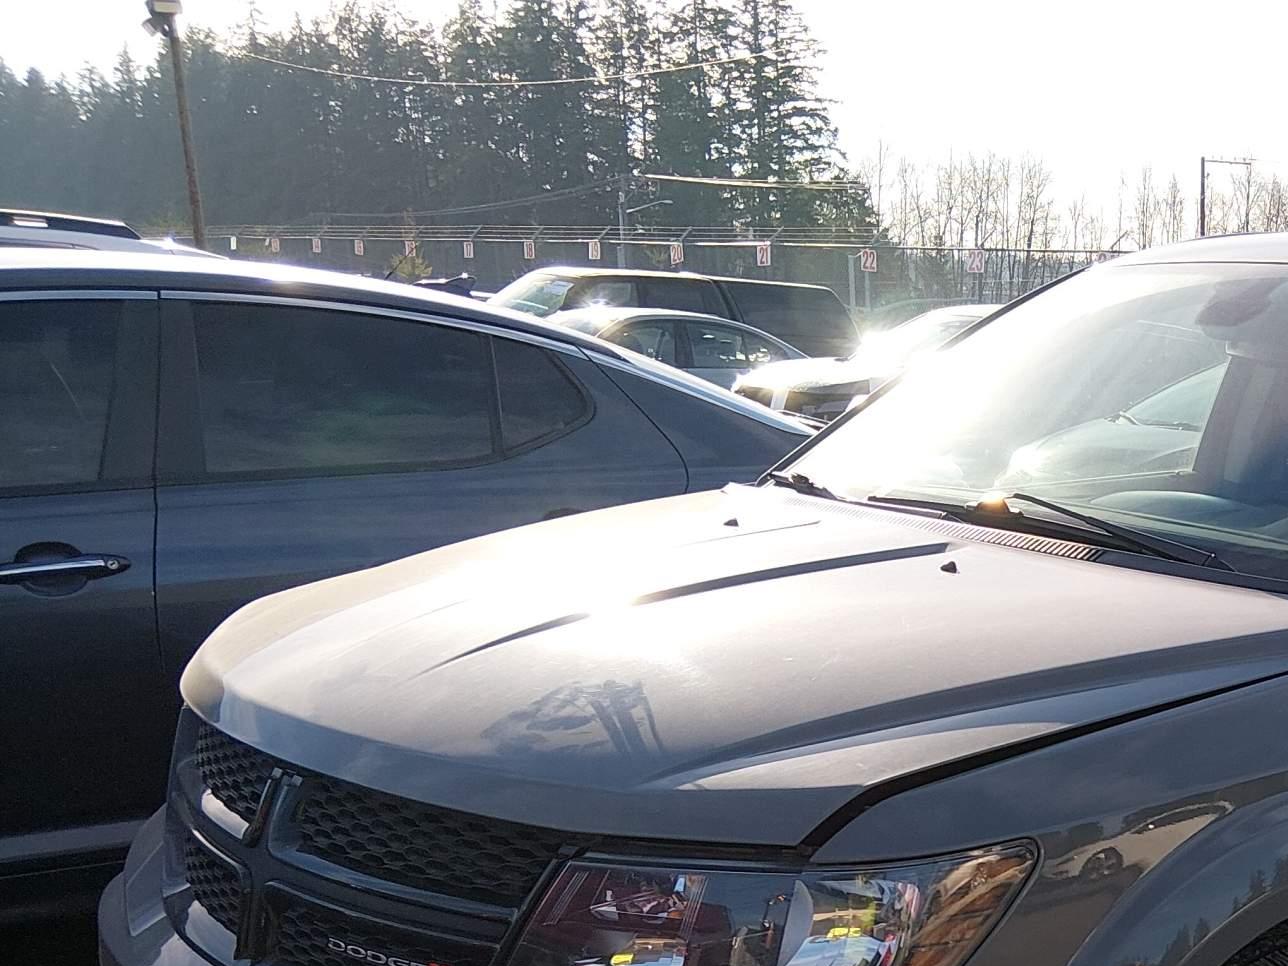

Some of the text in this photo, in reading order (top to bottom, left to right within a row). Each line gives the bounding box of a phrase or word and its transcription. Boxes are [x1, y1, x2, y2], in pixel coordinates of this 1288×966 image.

[525, 242, 533, 257] 18
[591, 242, 599, 258] 19
[671, 245, 682, 263] 20
[759, 246, 768, 264] 21
[862, 250, 875, 269] 22
[969, 251, 983, 271] 23
